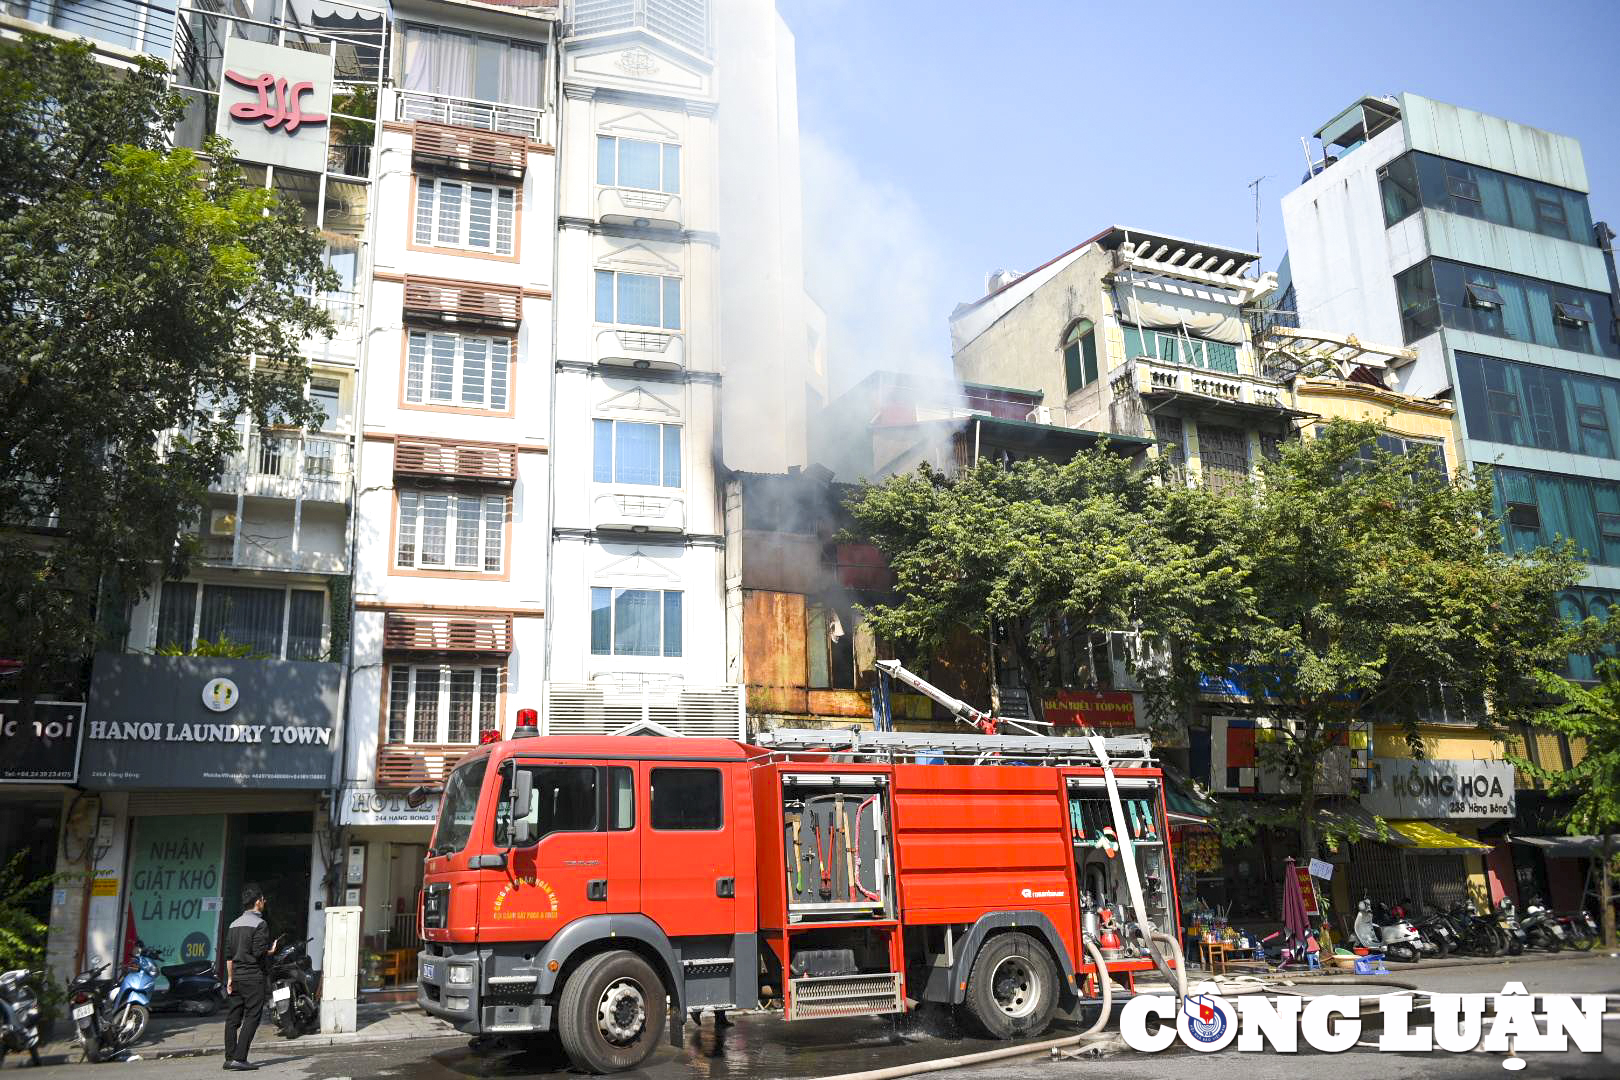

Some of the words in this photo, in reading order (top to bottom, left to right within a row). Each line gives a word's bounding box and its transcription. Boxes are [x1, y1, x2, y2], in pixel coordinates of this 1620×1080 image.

[0, 713, 74, 738] anoi
[89, 720, 163, 740] HANOI
[166, 723, 266, 743] LAUNDRY
[270, 725, 332, 745] TOWN
[1461, 774, 1504, 798] HOA
[150, 837, 205, 864] NHẬN
[134, 865, 176, 896] GIẶT
[178, 864, 217, 890] KHÔ
[142, 894, 163, 921] LÀ
[168, 898, 203, 921] HƠI
[186, 943, 205, 957] 30K
